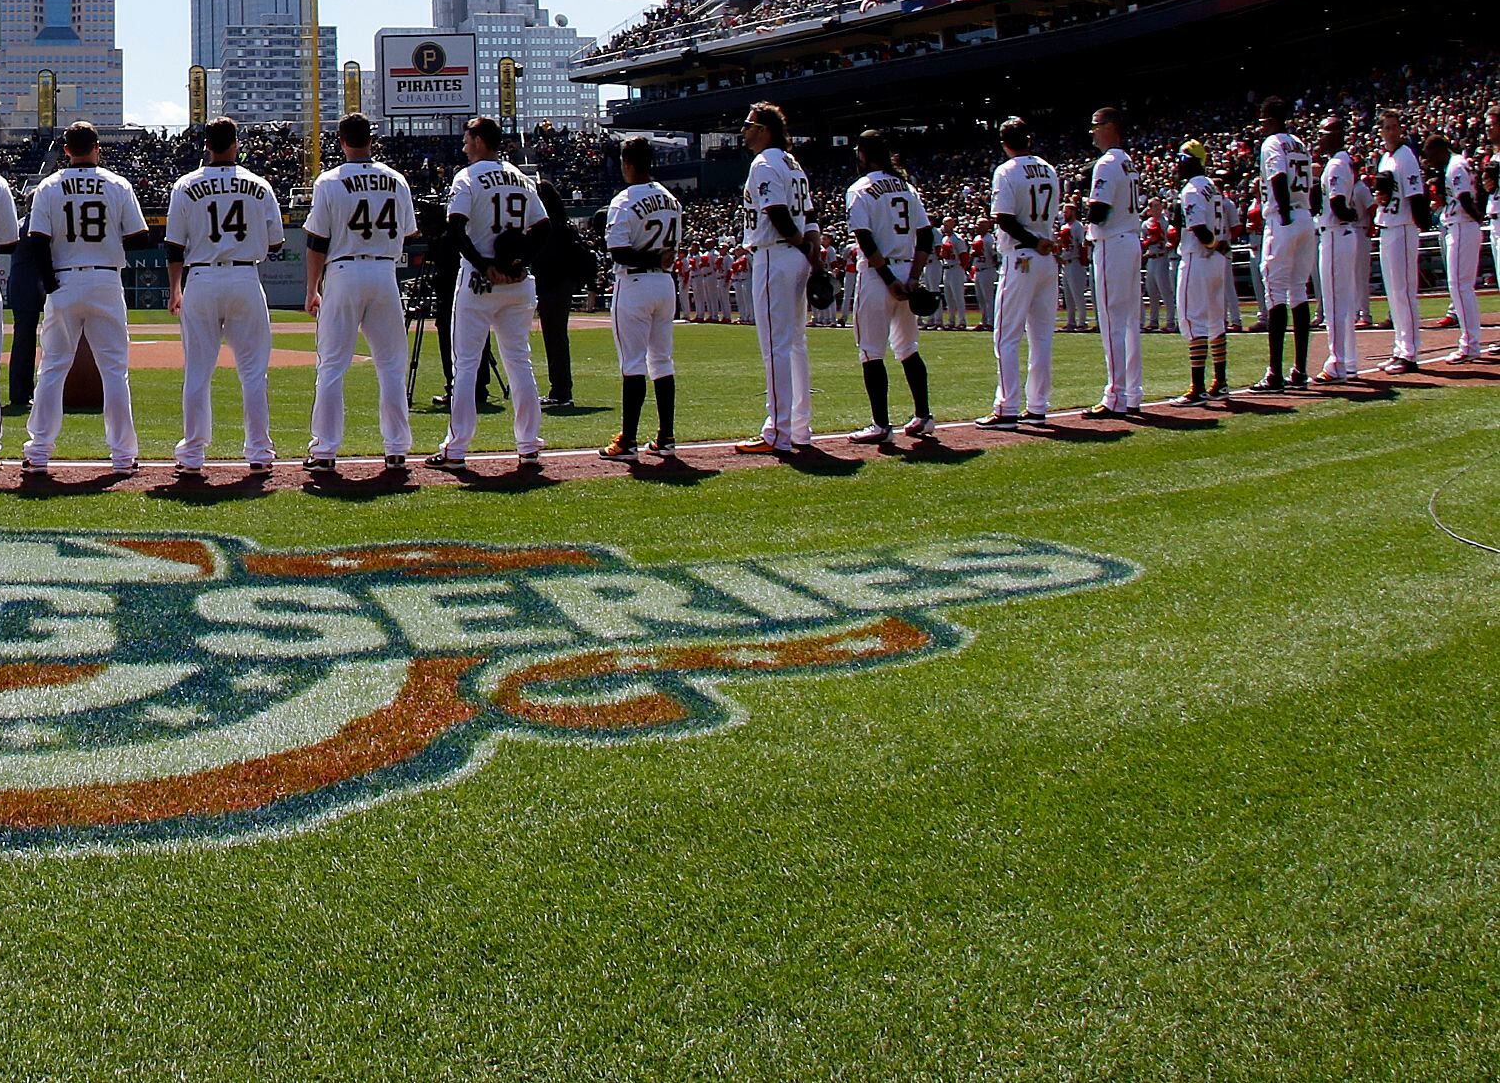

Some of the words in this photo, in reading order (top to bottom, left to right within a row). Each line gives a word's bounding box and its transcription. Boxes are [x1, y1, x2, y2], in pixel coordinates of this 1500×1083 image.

[422, 50, 437, 69] P
[397, 79, 462, 92] PIRATES
[397, 93, 463, 103] CHARITIES
[61, 177, 105, 196] NIESE
[183, 176, 266, 201] VOGELSONG
[341, 175, 397, 194] WATSON
[1289, 159, 1309, 194] 25
[206, 199, 248, 242] 14
[348, 198, 399, 240] 44
[491, 192, 528, 234] 19
[891, 197, 910, 235] 3
[1028, 184, 1053, 222] 17
[62, 200, 107, 243] 18
[639, 218, 677, 252] 24
[194, 533, 1102, 658] SERIES
